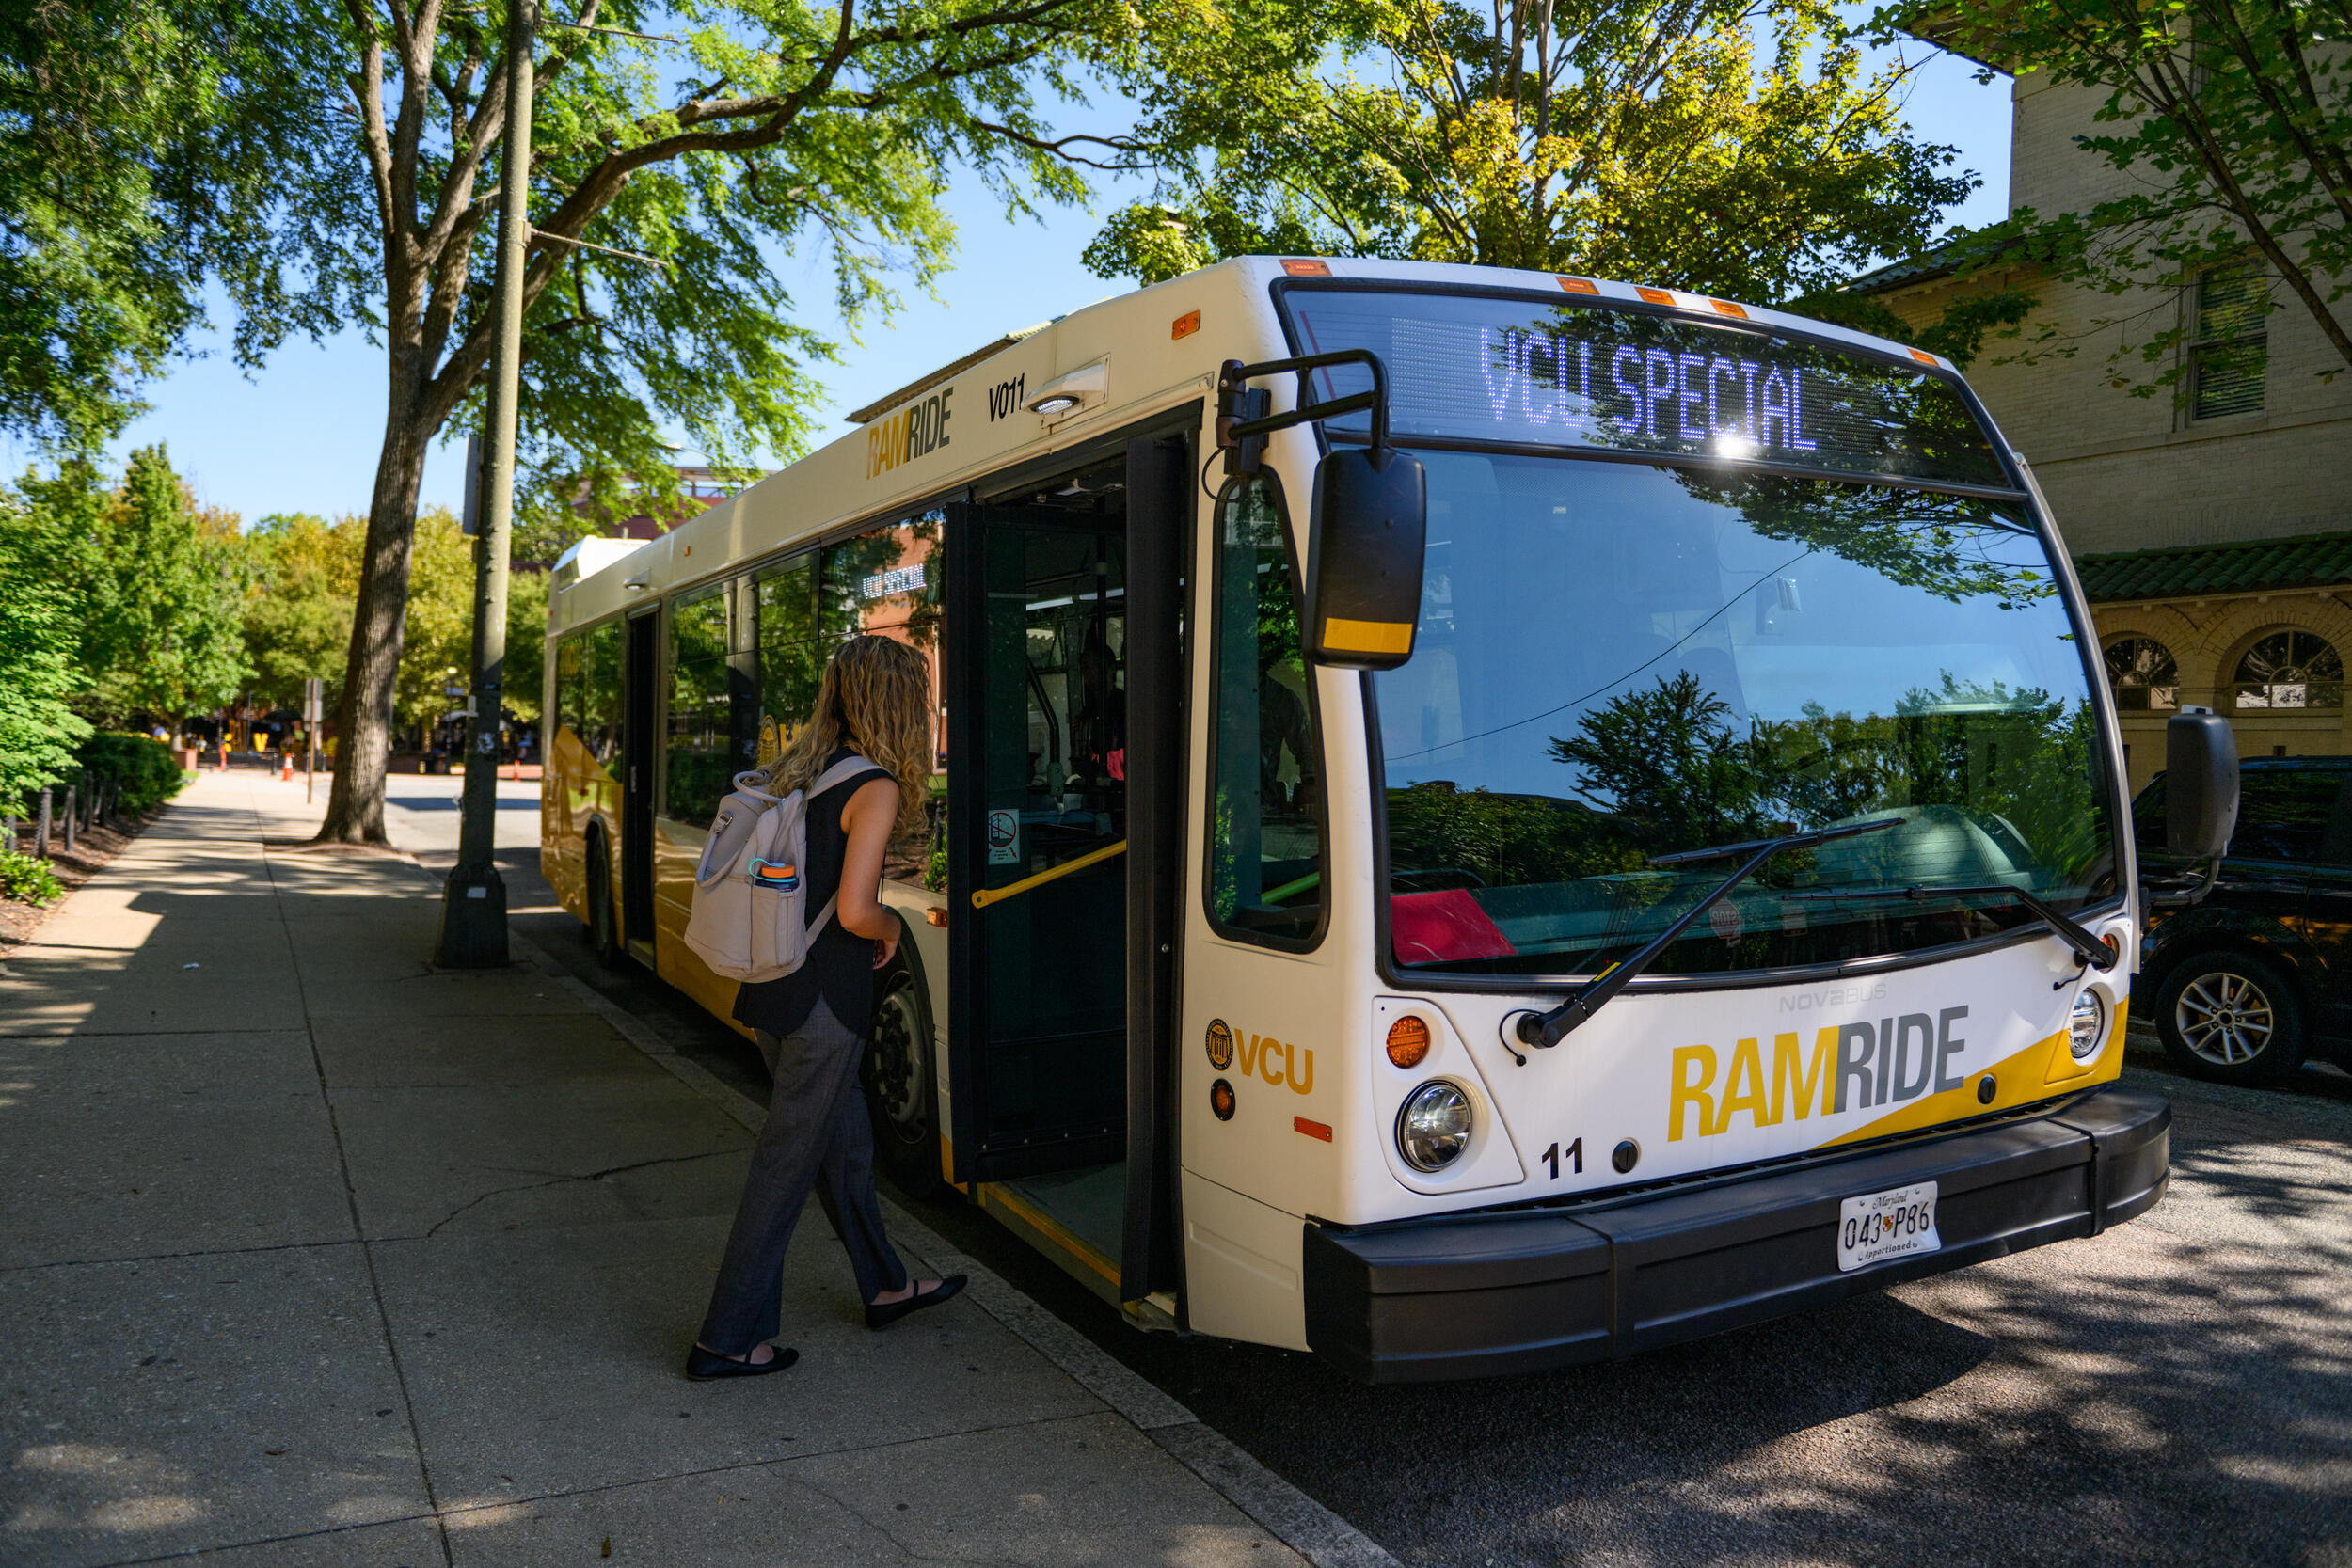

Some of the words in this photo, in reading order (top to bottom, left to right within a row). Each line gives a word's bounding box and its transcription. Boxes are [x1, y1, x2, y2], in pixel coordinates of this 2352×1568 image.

[989, 373, 1025, 422] V011
[1481, 327, 1590, 428] VCU
[1613, 342, 1818, 451] SPECIAL
[866, 387, 954, 481] RAMRIDE
[1234, 1028, 1314, 1095] VCU
[1668, 1005, 1970, 1143] RAMRIDE
[1542, 1136, 1582, 1180] 11
[1872, 1190, 1908, 1210] Maryland
[1864, 1241, 1912, 1259] Apportioned
